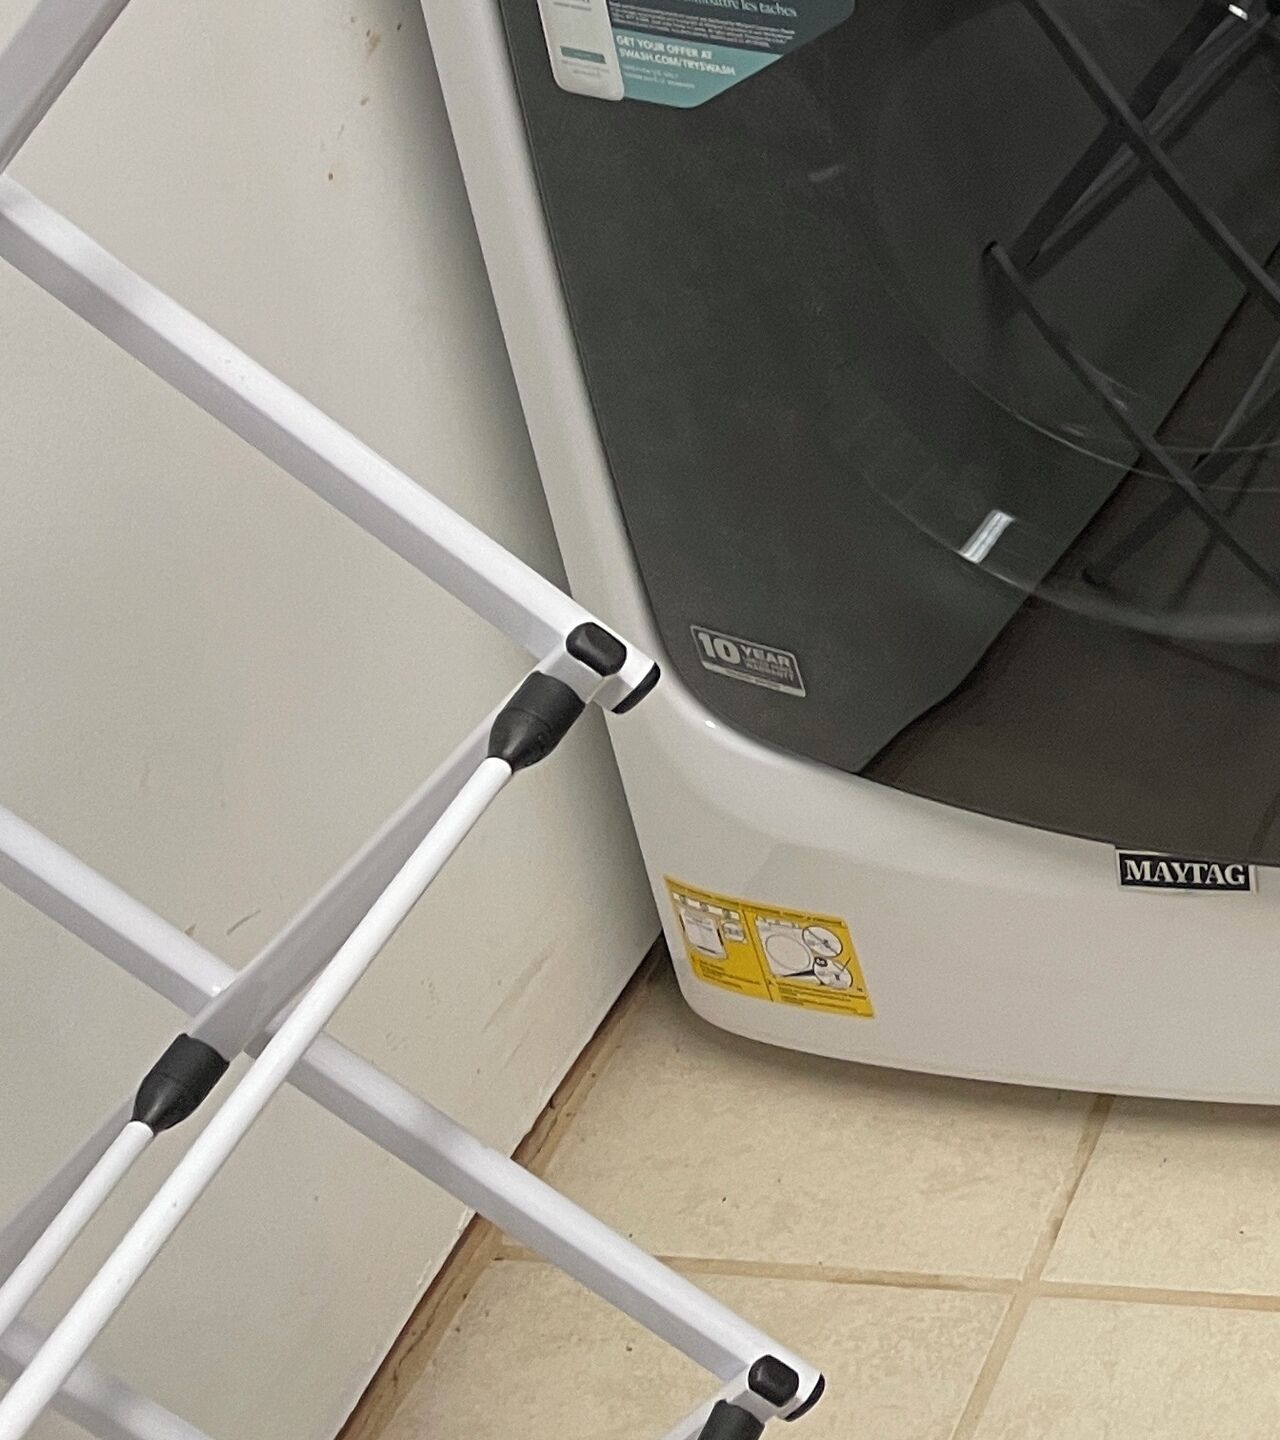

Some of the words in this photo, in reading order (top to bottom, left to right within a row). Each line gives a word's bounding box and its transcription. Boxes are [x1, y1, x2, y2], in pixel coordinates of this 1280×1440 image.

[741, 0, 757, 12] les
[759, 1, 797, 17] taches
[616, 35, 635, 47] GET
[637, 39, 665, 52] YOUR
[667, 44, 698, 58] OFFER
[700, 49, 713, 60] AT
[619, 46, 736, 76] SWASH.COM/TRYSWASH
[698, 632, 741, 664] 10
[740, 644, 791, 667] YEAR
[1124, 859, 1246, 886] MAYTAG
